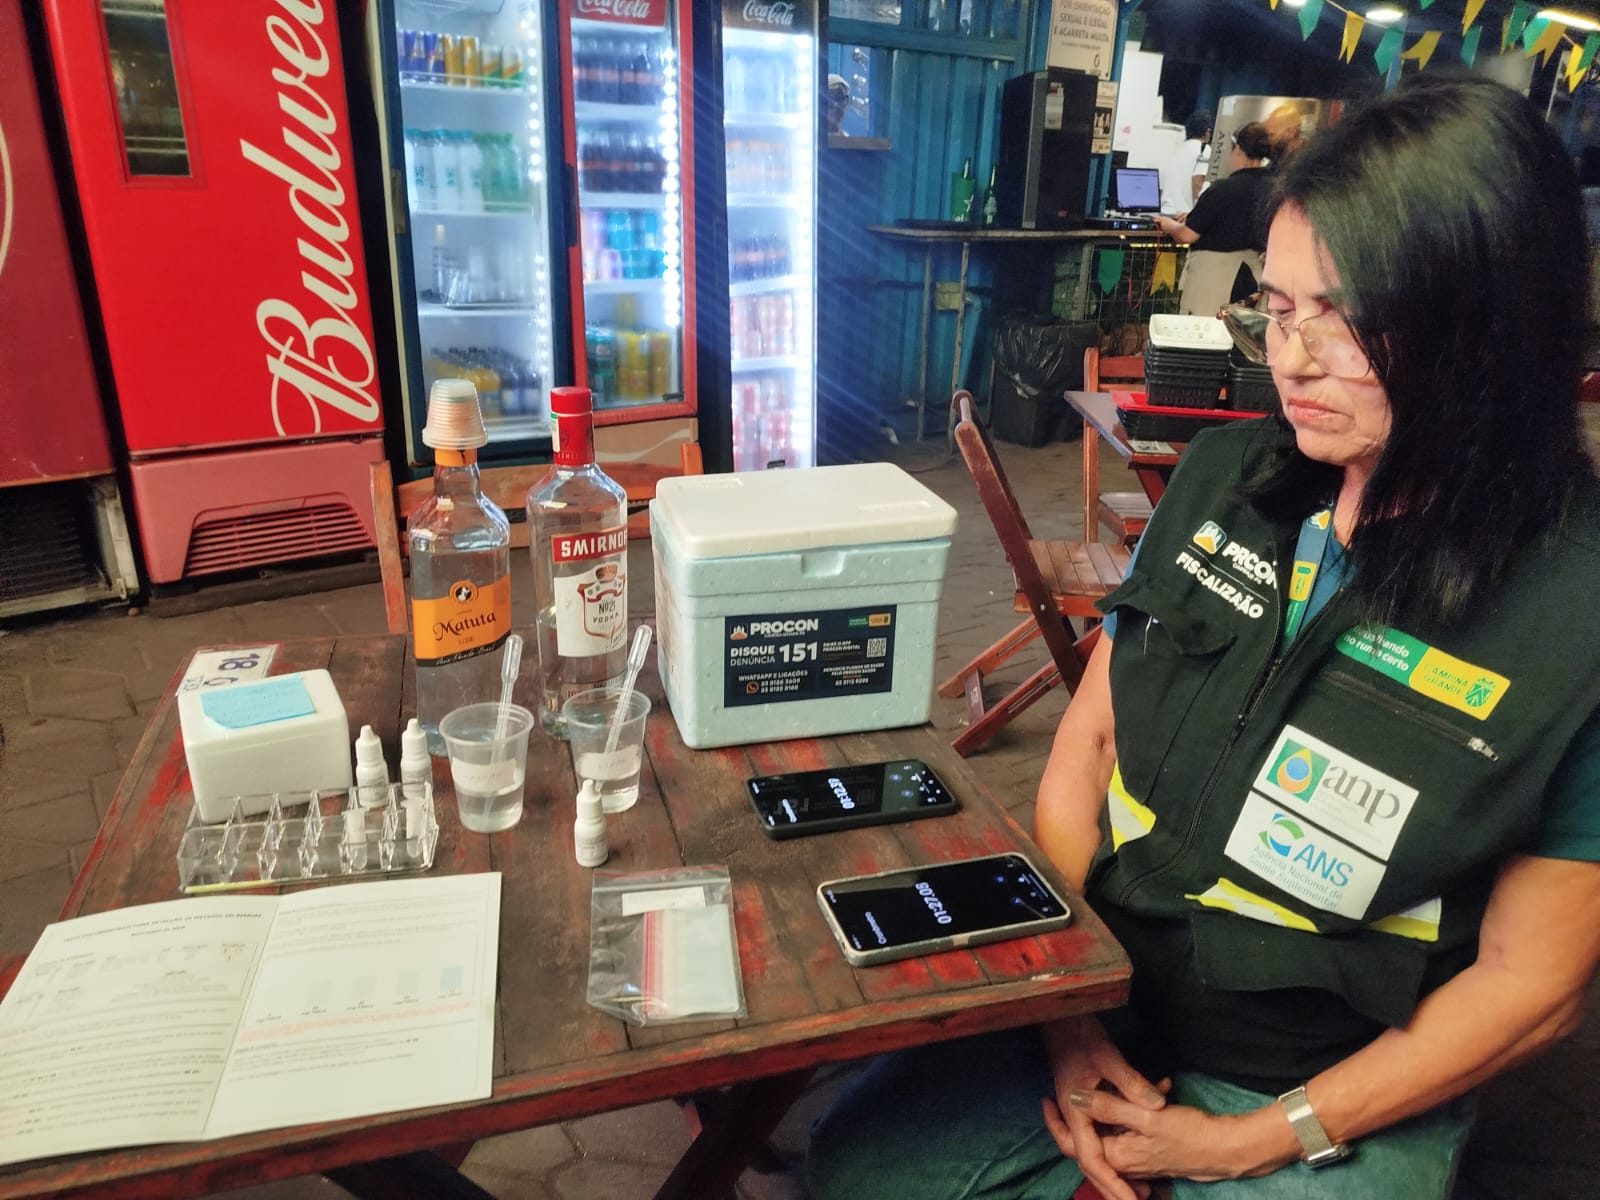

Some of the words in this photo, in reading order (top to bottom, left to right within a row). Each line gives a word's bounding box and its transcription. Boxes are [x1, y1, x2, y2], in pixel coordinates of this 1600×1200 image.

[433, 611, 496, 641] Matuta
[592, 612, 619, 623] VODKA
[750, 618, 819, 636] PROCON
[217, 652, 261, 671] 18
[731, 645, 775, 658] DISQUE
[779, 641, 818, 663] 151
[731, 655, 775, 666] DENÚNCIA
[1382, 653, 1410, 671] certo
[738, 673, 772, 682] WHATSAPP
[778, 669, 808, 679] LIGAÇÕES
[1424, 664, 1469, 687] CAMPINA
[1322, 766, 1401, 826] anp
[1253, 845, 1286, 874] Agência
[1288, 865, 1329, 893] Nacional
[1329, 885, 1344, 900] de
[1292, 843, 1354, 888] ANS
[1250, 855, 1277, 878] Saúde
[1277, 871, 1338, 910] Suplementar
